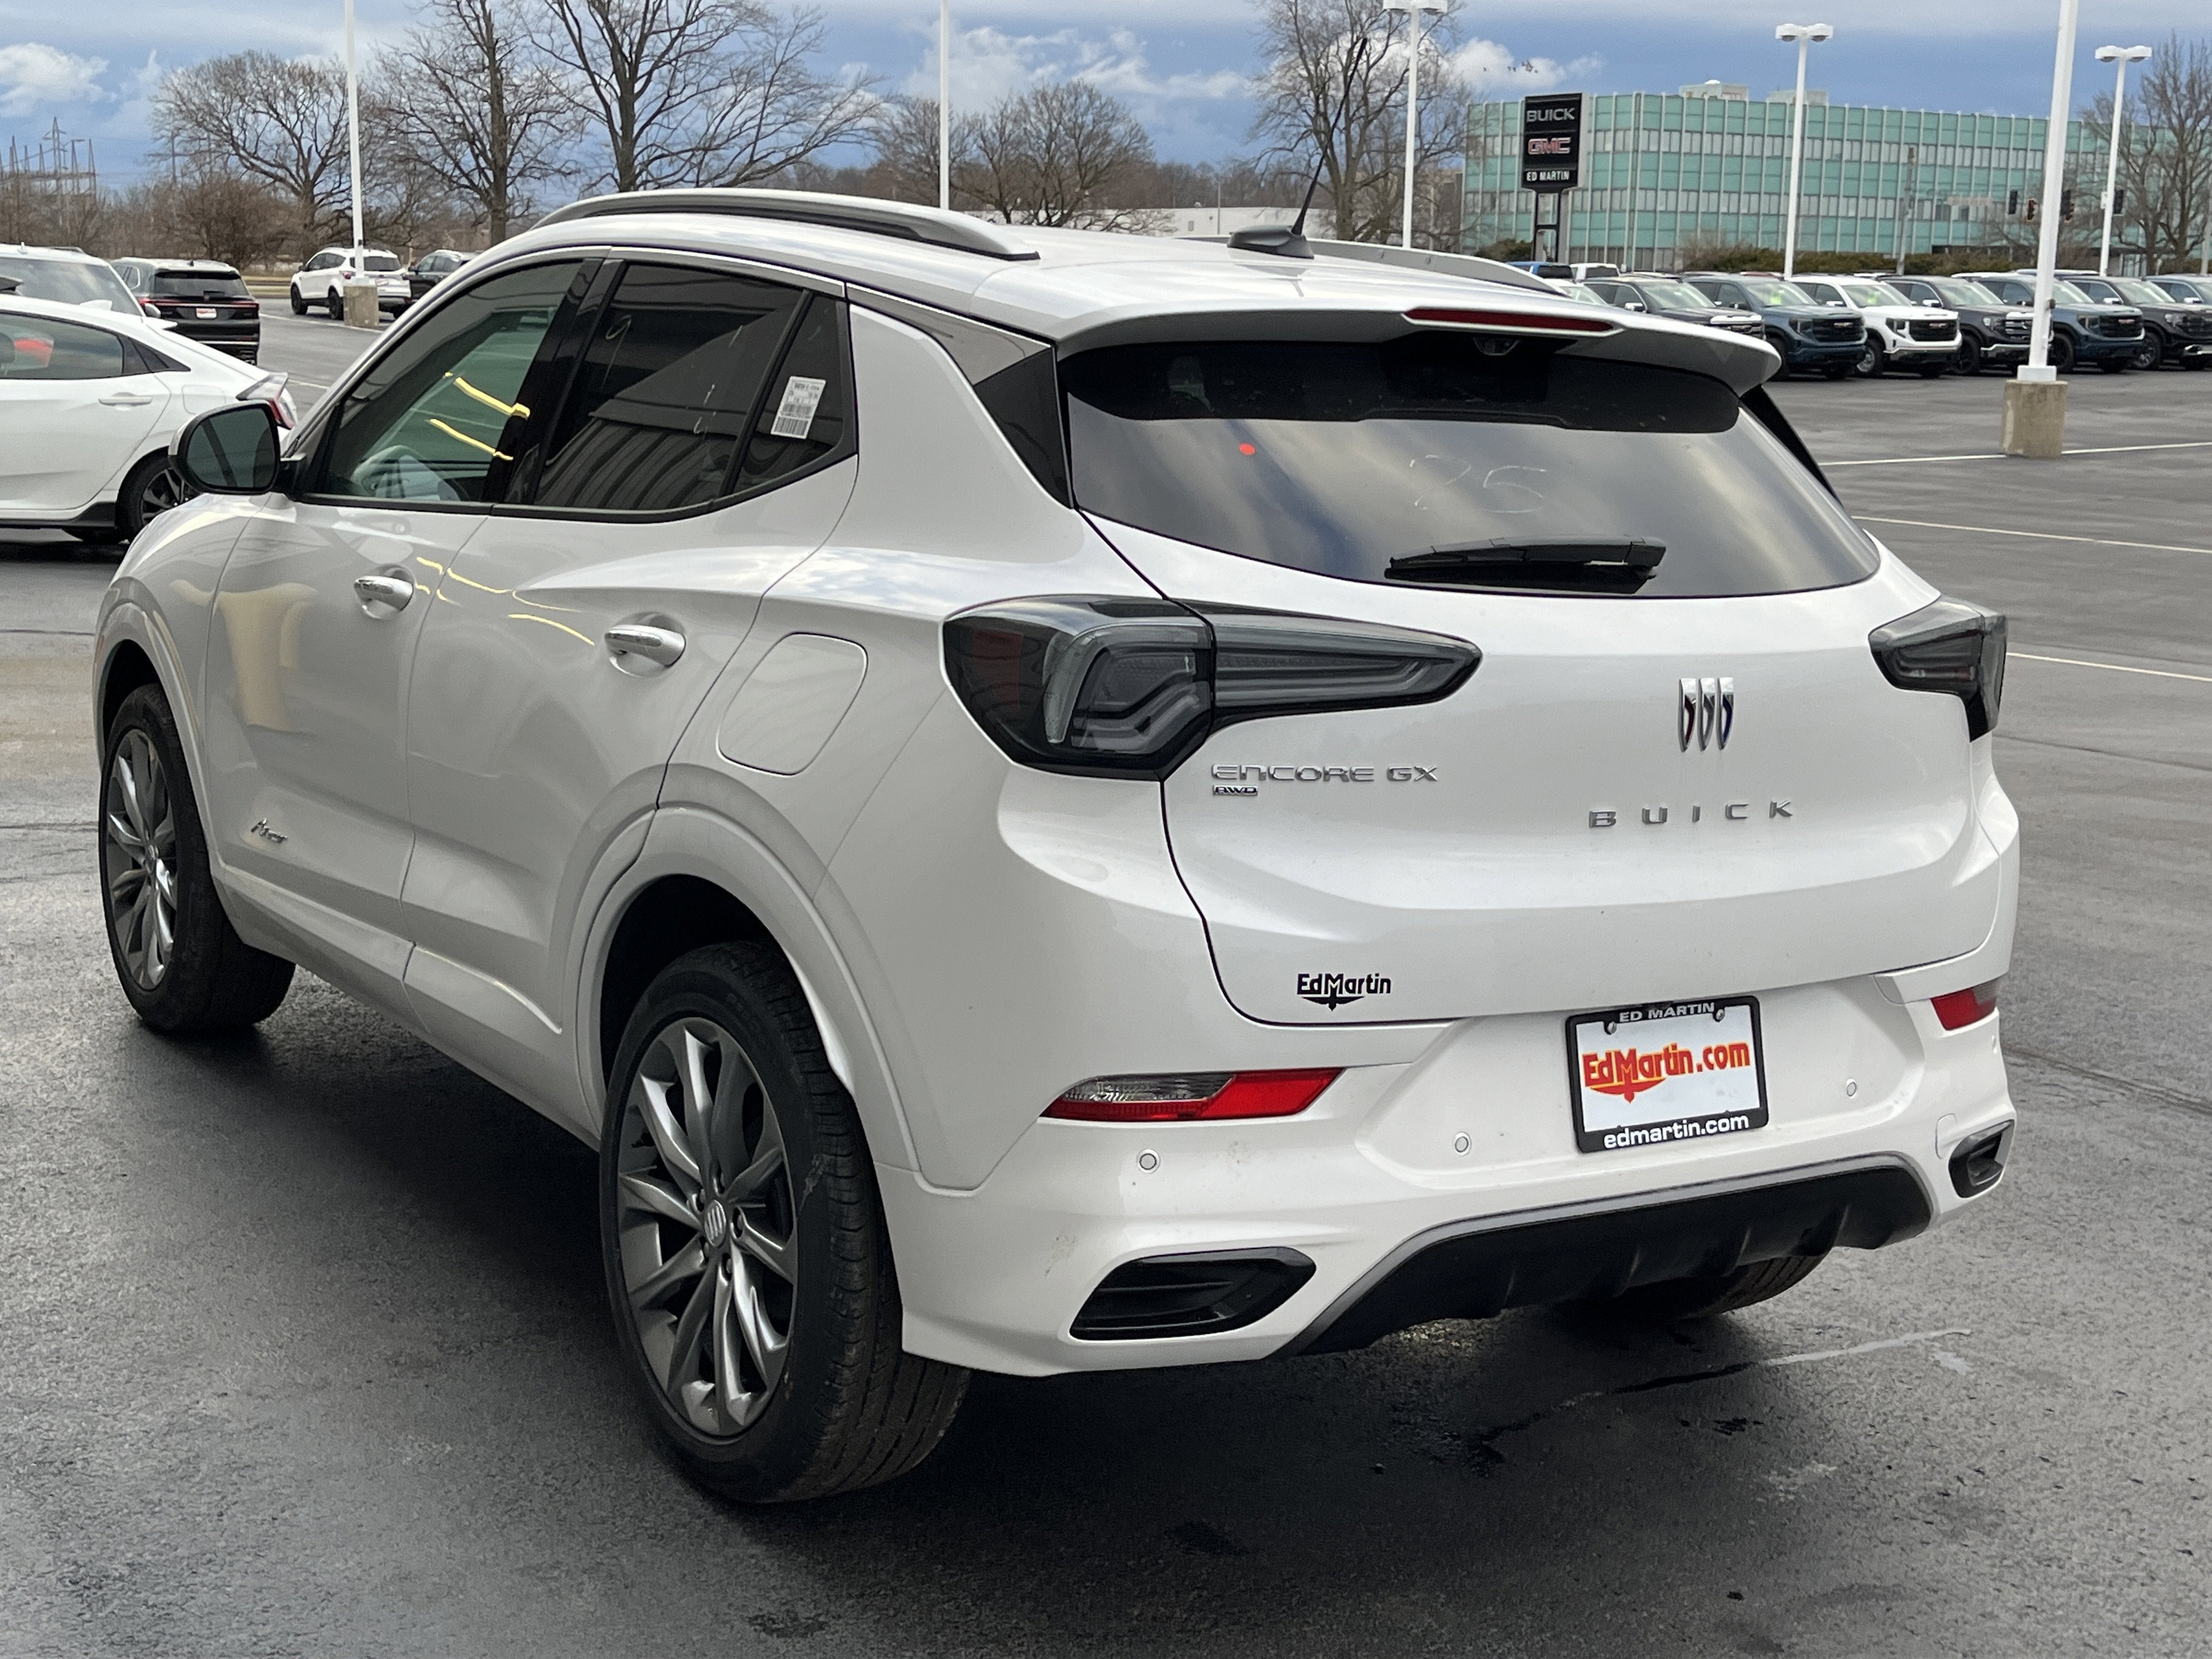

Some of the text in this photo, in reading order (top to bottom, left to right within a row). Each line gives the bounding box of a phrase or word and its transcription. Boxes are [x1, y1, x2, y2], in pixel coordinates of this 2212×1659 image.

[1526, 108, 1575, 122] BUICK
[1528, 137, 1571, 155] GMC
[1526, 171, 1570, 181] ED MARTIN
[1211, 764, 1438, 782] ENCORE GX
[1213, 785, 1259, 796] AWD
[1589, 800, 1793, 828] BUICK
[1297, 973, 1392, 995] EdMartin
[1619, 1002, 1716, 1023] ED MARTIN
[1582, 1042, 1751, 1087] EdMartin.com
[1604, 1114, 1750, 1149] edmartin.com
